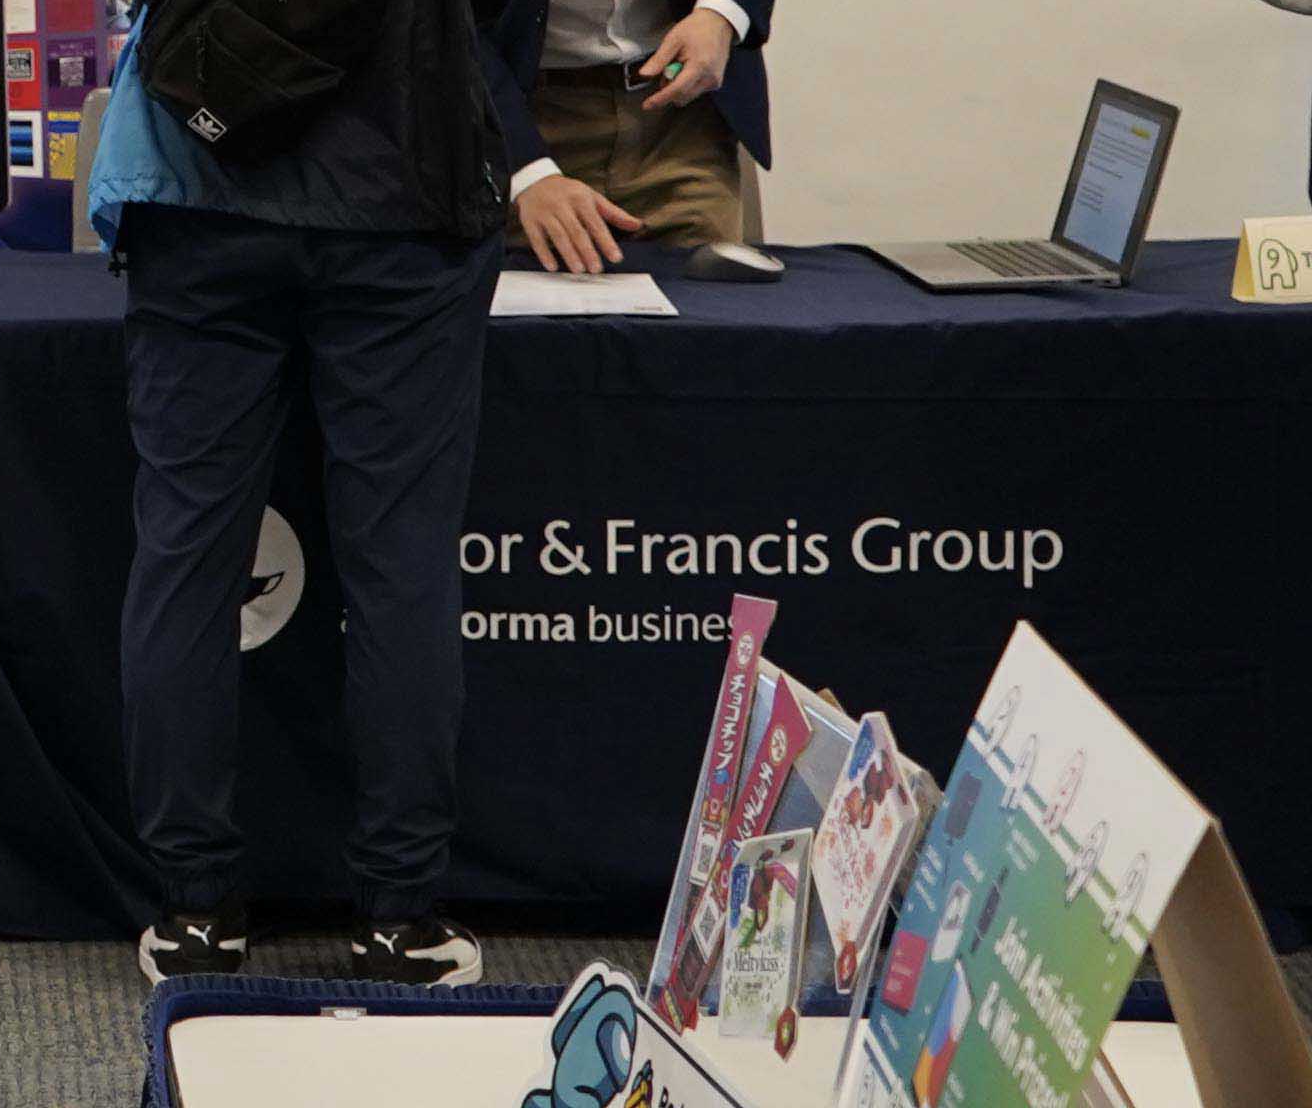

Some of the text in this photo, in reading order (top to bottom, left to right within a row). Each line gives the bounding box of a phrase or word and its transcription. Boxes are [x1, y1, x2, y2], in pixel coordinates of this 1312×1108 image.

[539, 519, 592, 576] &
[606, 517, 830, 575] Francis
[851, 516, 1064, 589] Group
[460, 605, 735, 643] orma busine
